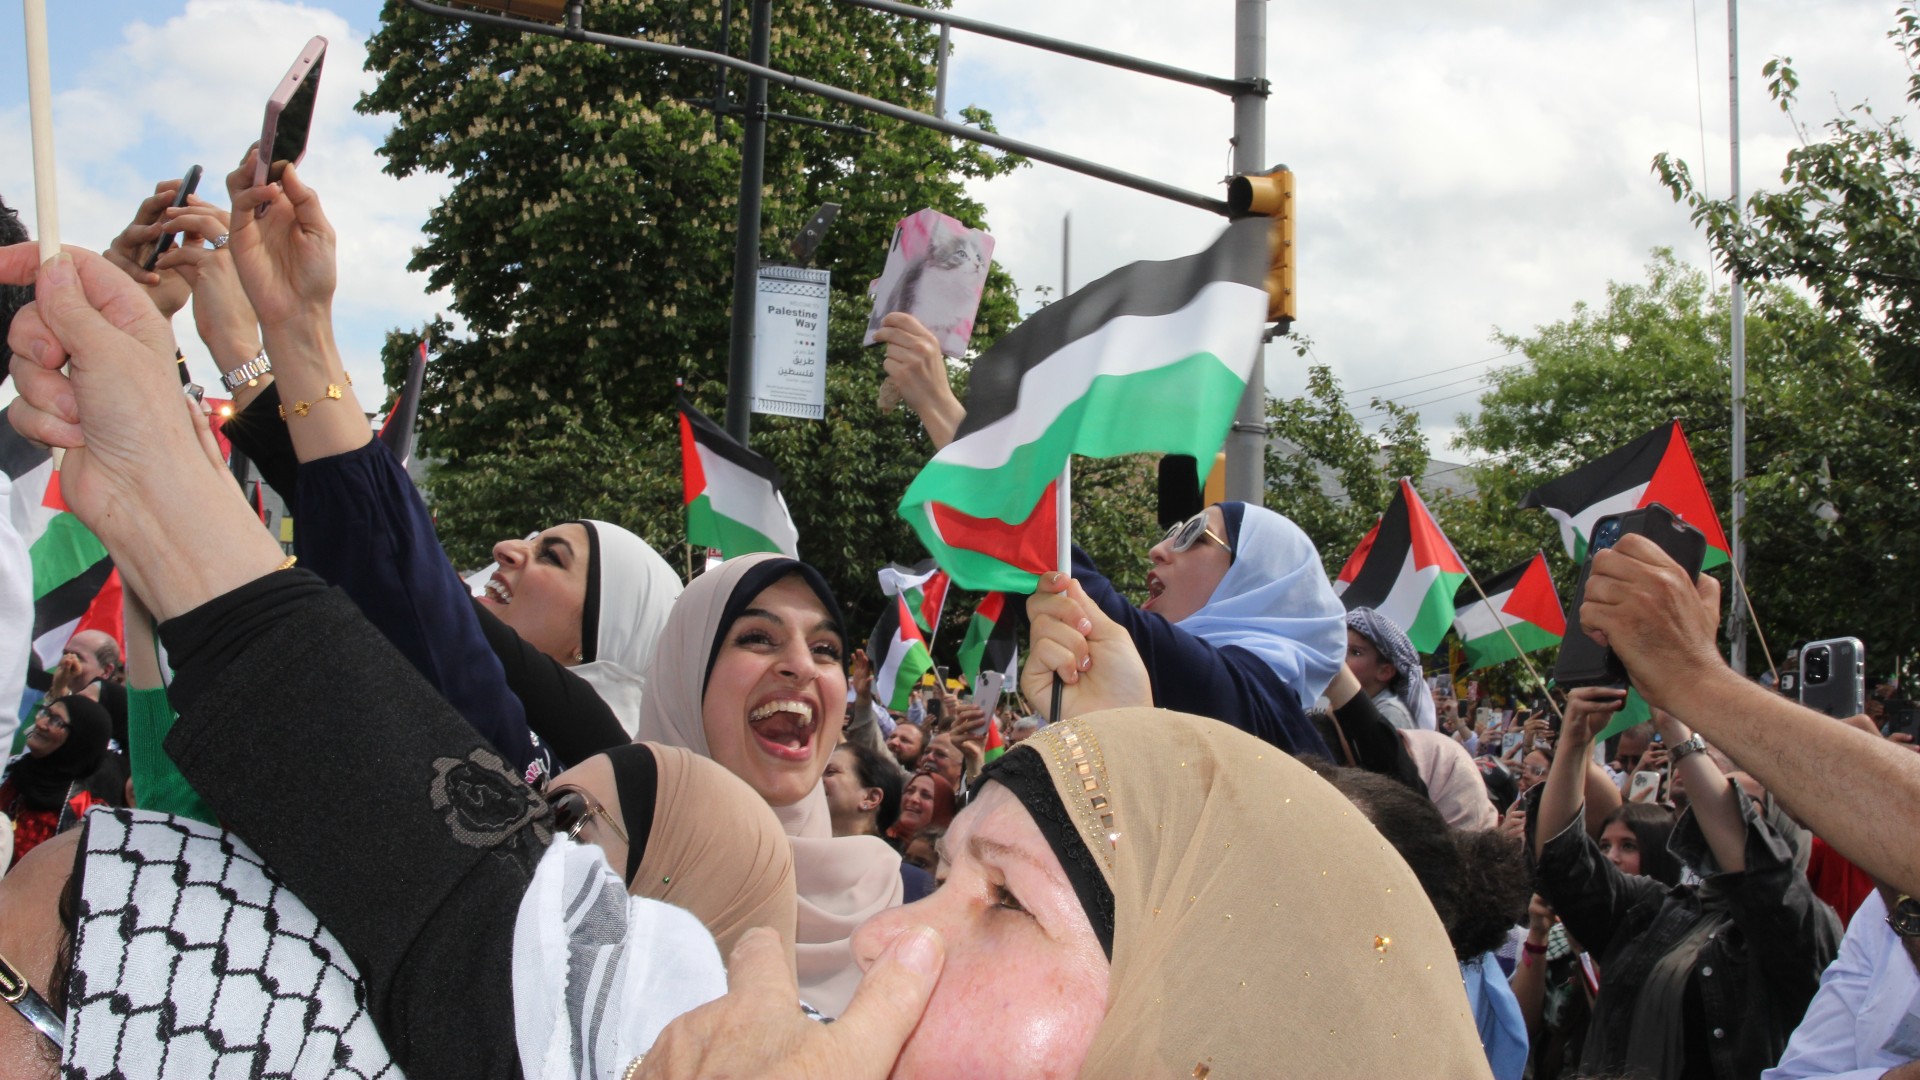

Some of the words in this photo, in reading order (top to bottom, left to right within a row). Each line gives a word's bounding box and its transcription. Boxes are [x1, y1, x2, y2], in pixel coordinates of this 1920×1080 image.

[768, 305, 818, 320] Palestine
[795, 318, 817, 331] Way
[792, 355, 815, 366] طريق
[777, 366, 815, 378] فلسطين
[0, 972, 16, 992] ADDEN
